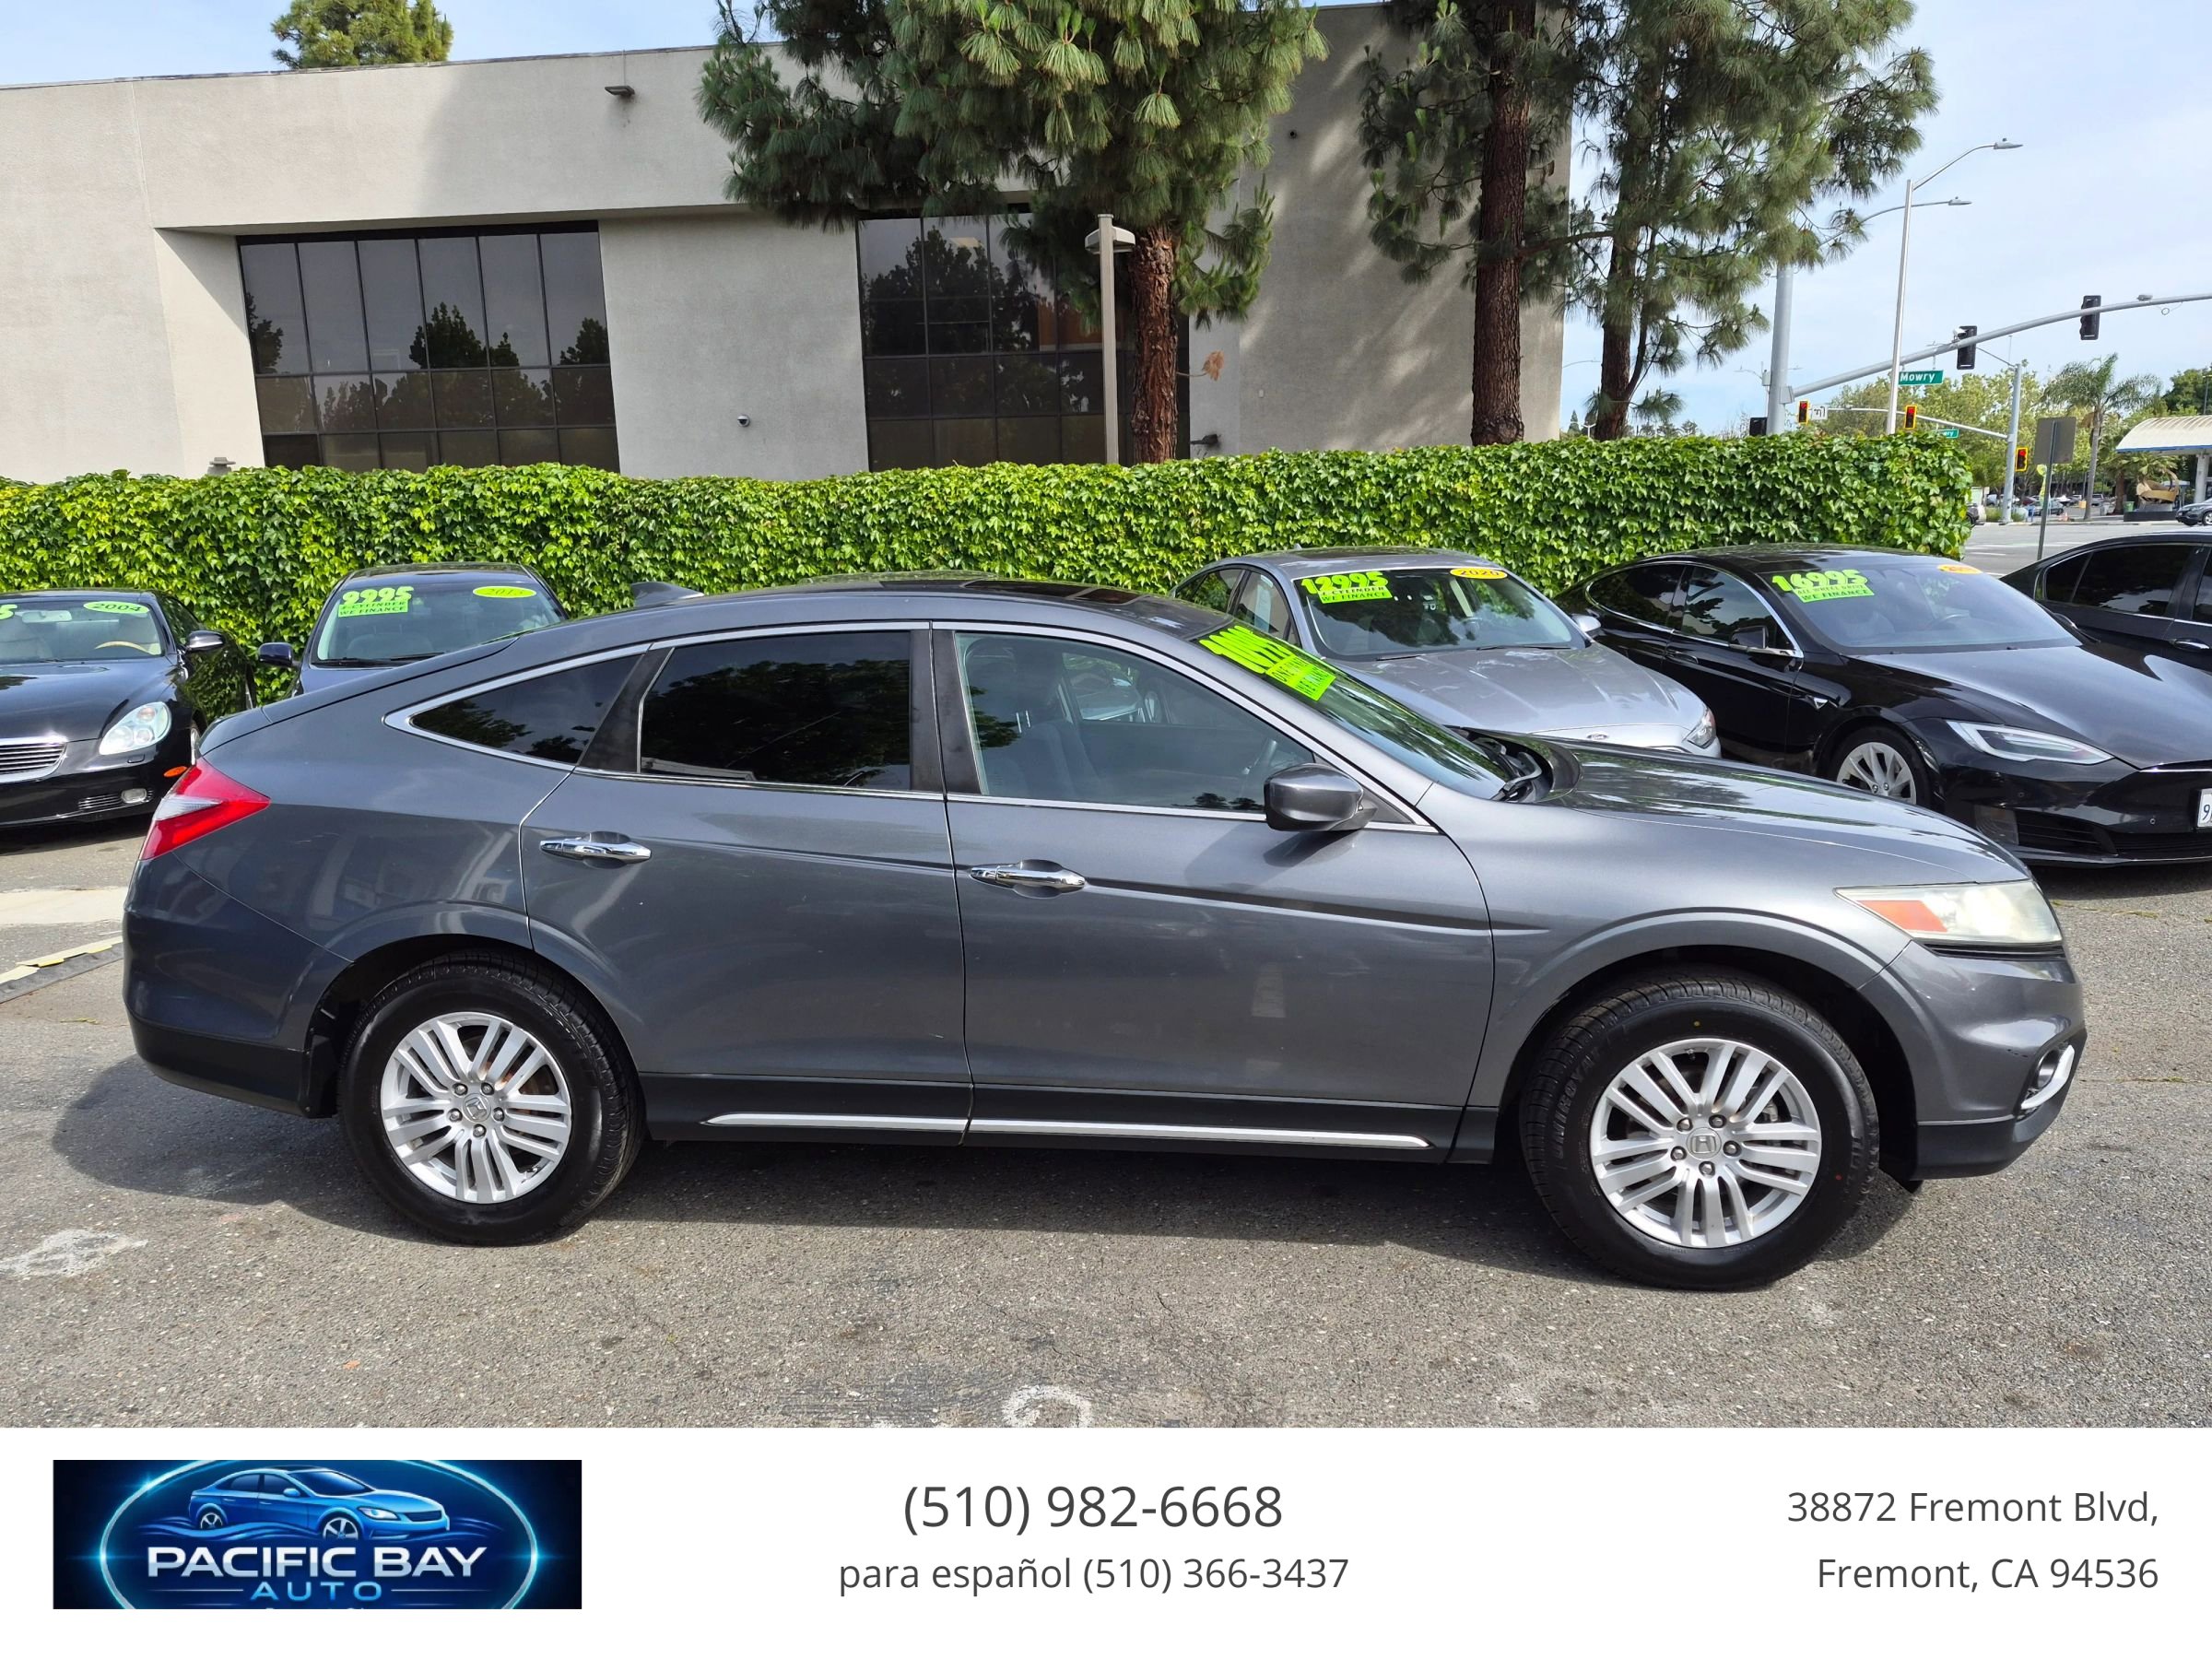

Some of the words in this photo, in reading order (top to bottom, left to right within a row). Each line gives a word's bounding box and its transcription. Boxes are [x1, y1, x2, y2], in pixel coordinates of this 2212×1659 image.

[1900, 372, 1935, 382] Mowry
[1301, 571, 1388, 594] 12995
[1772, 570, 1868, 592] 16995
[1332, 586, 1384, 595] CYLINDER
[1802, 593, 1818, 601] WE
[1822, 589, 1868, 598] FINANCE
[343, 586, 414, 605] 9995
[1342, 591, 1386, 600] FINANCE
[94, 603, 141, 612] 2004
[352, 601, 405, 609] CYLINDER
[359, 606, 404, 614] FINANCE
